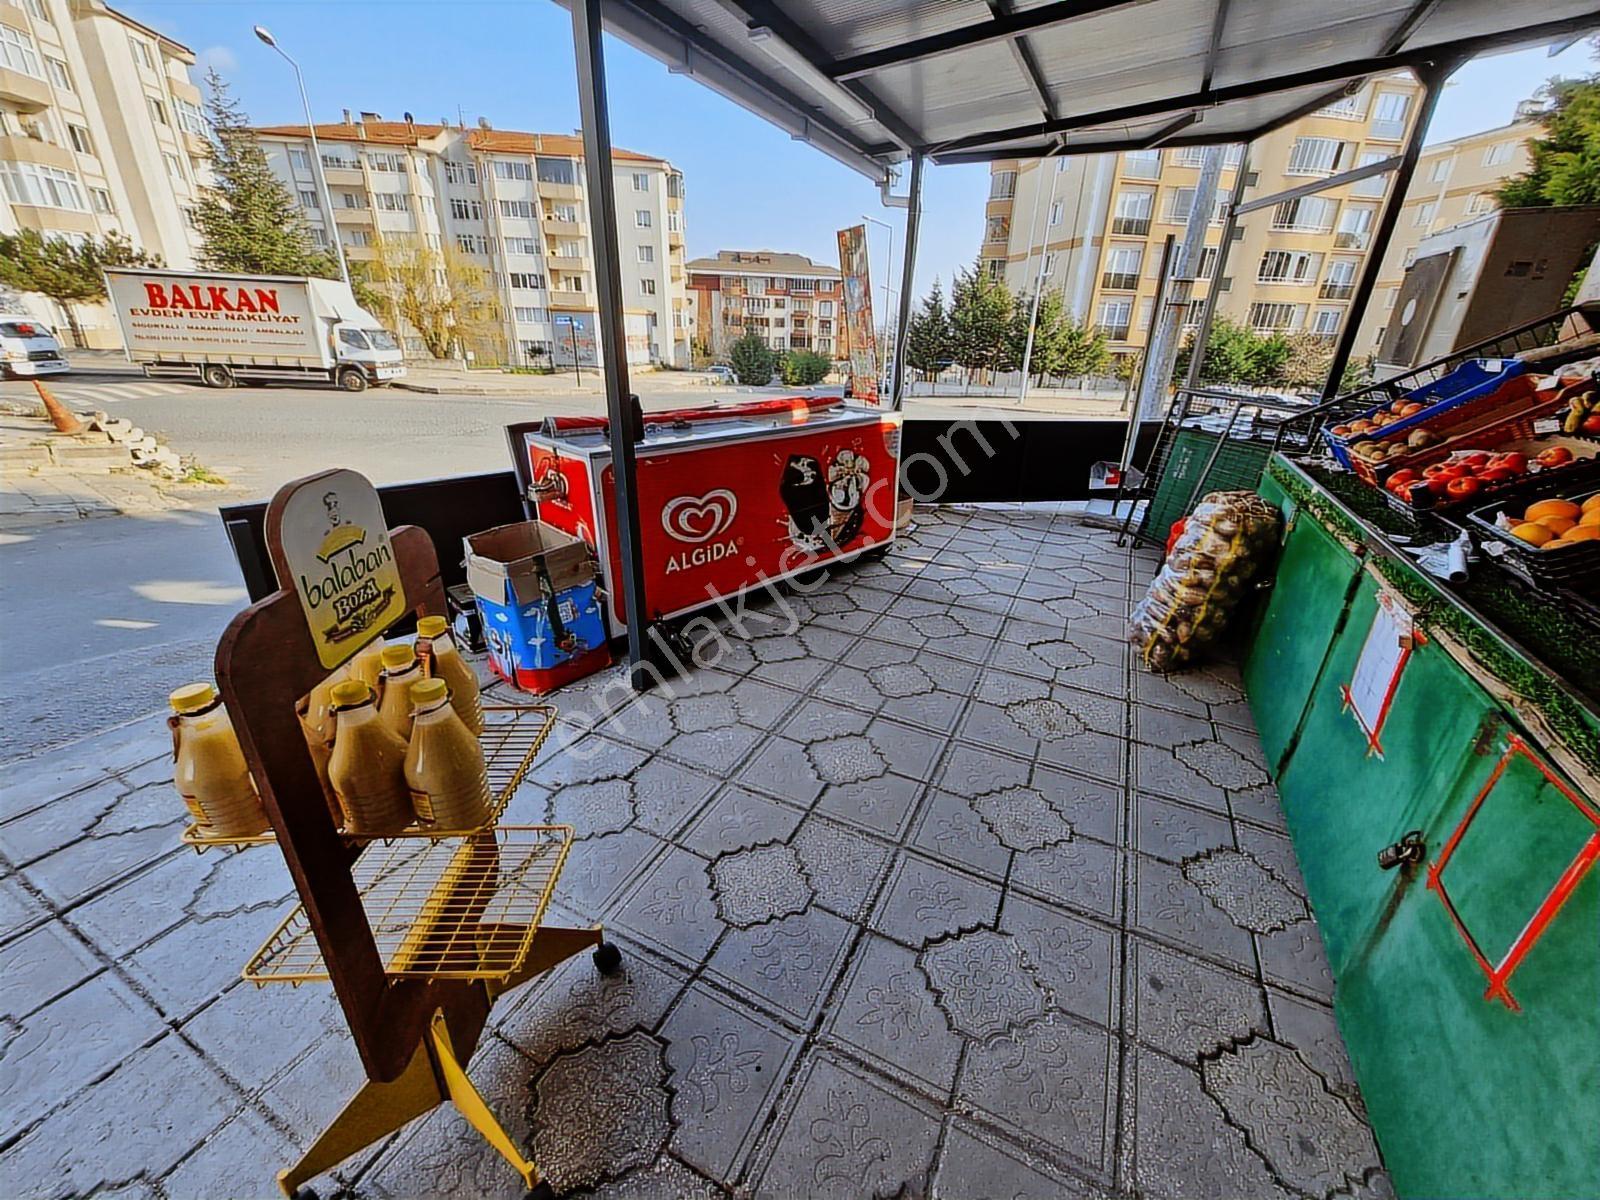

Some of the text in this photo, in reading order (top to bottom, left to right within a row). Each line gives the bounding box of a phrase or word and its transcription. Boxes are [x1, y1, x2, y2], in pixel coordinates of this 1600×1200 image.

[130, 308, 300, 323] EVDEN EVE NAKLİYAT
[144, 283, 279, 313] BALKAN
[301, 545, 391, 609] balaban
[333, 578, 382, 623] BOZA
